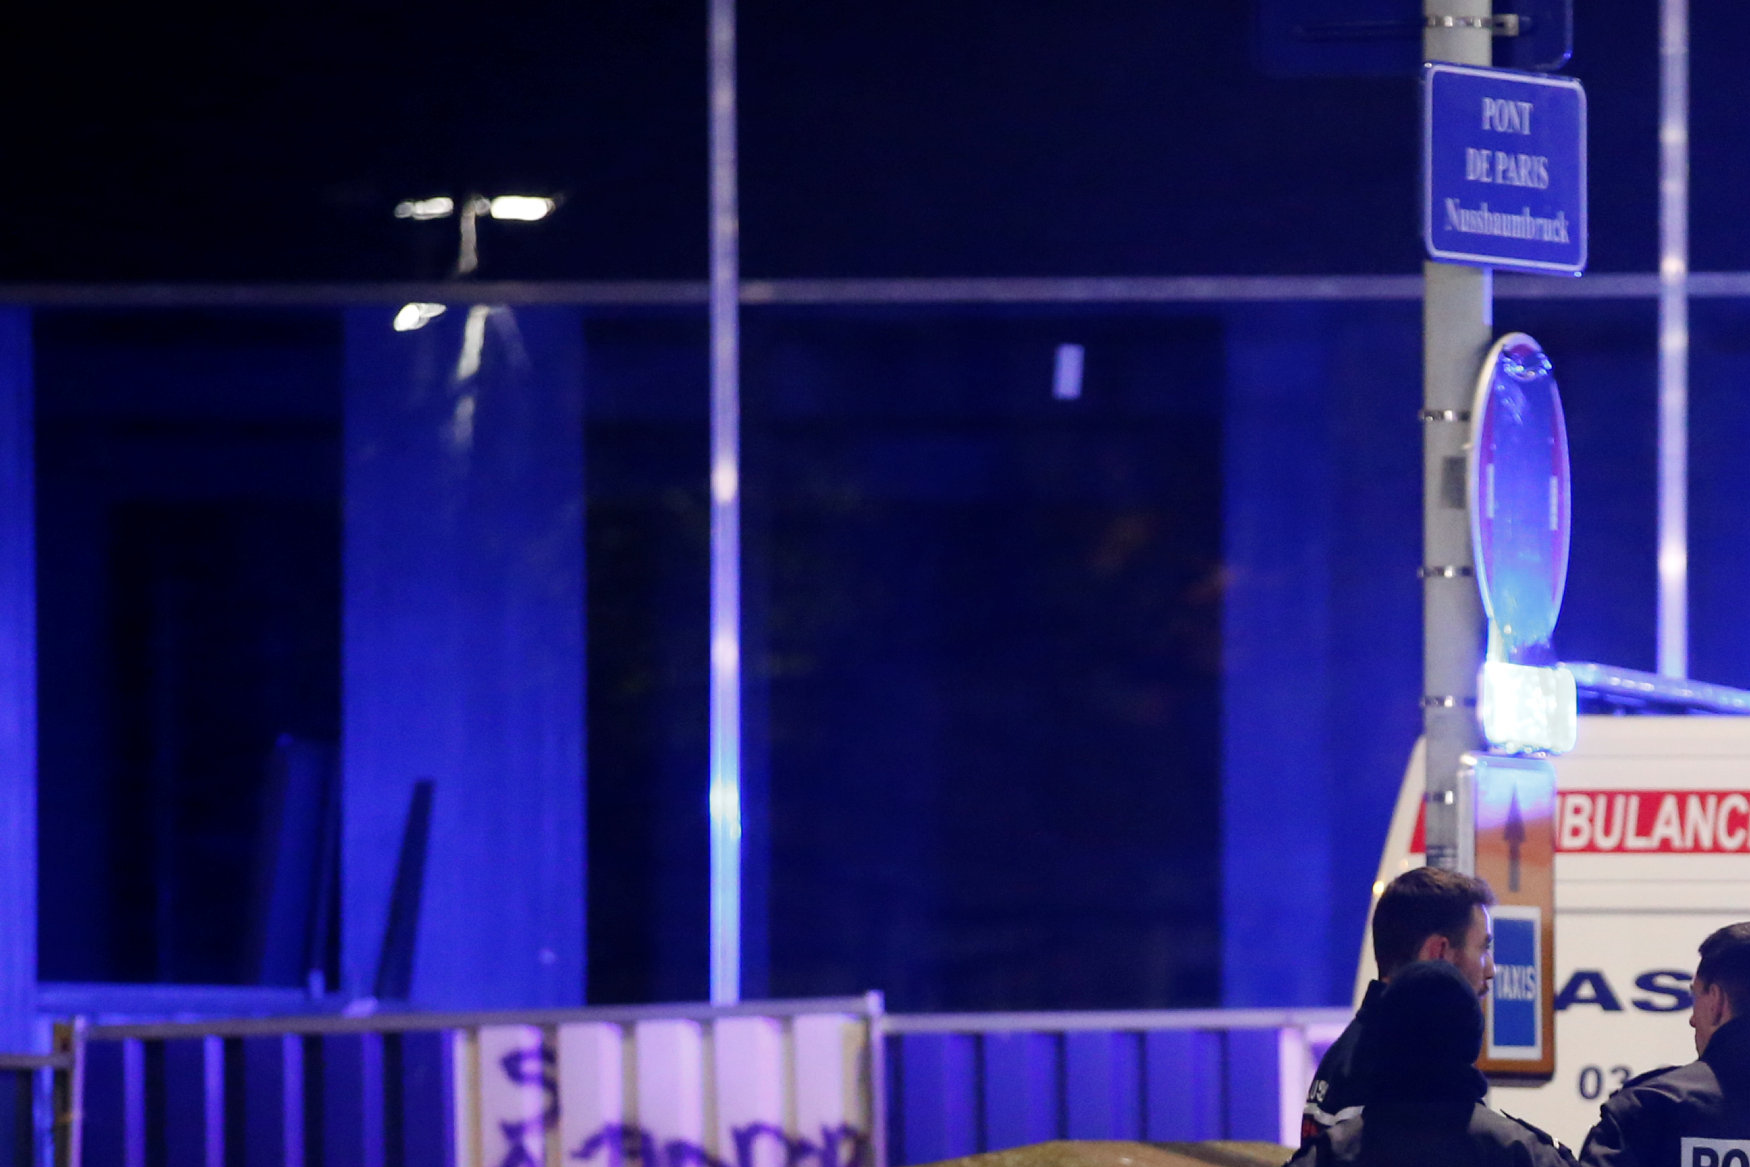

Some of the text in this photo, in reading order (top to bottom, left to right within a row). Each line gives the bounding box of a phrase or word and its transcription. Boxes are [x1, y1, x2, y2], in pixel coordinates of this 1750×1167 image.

[1481, 97, 1534, 135] PONT
[1465, 147, 1549, 189] DE PARIS
[1494, 964, 1537, 1000] TAXIS
